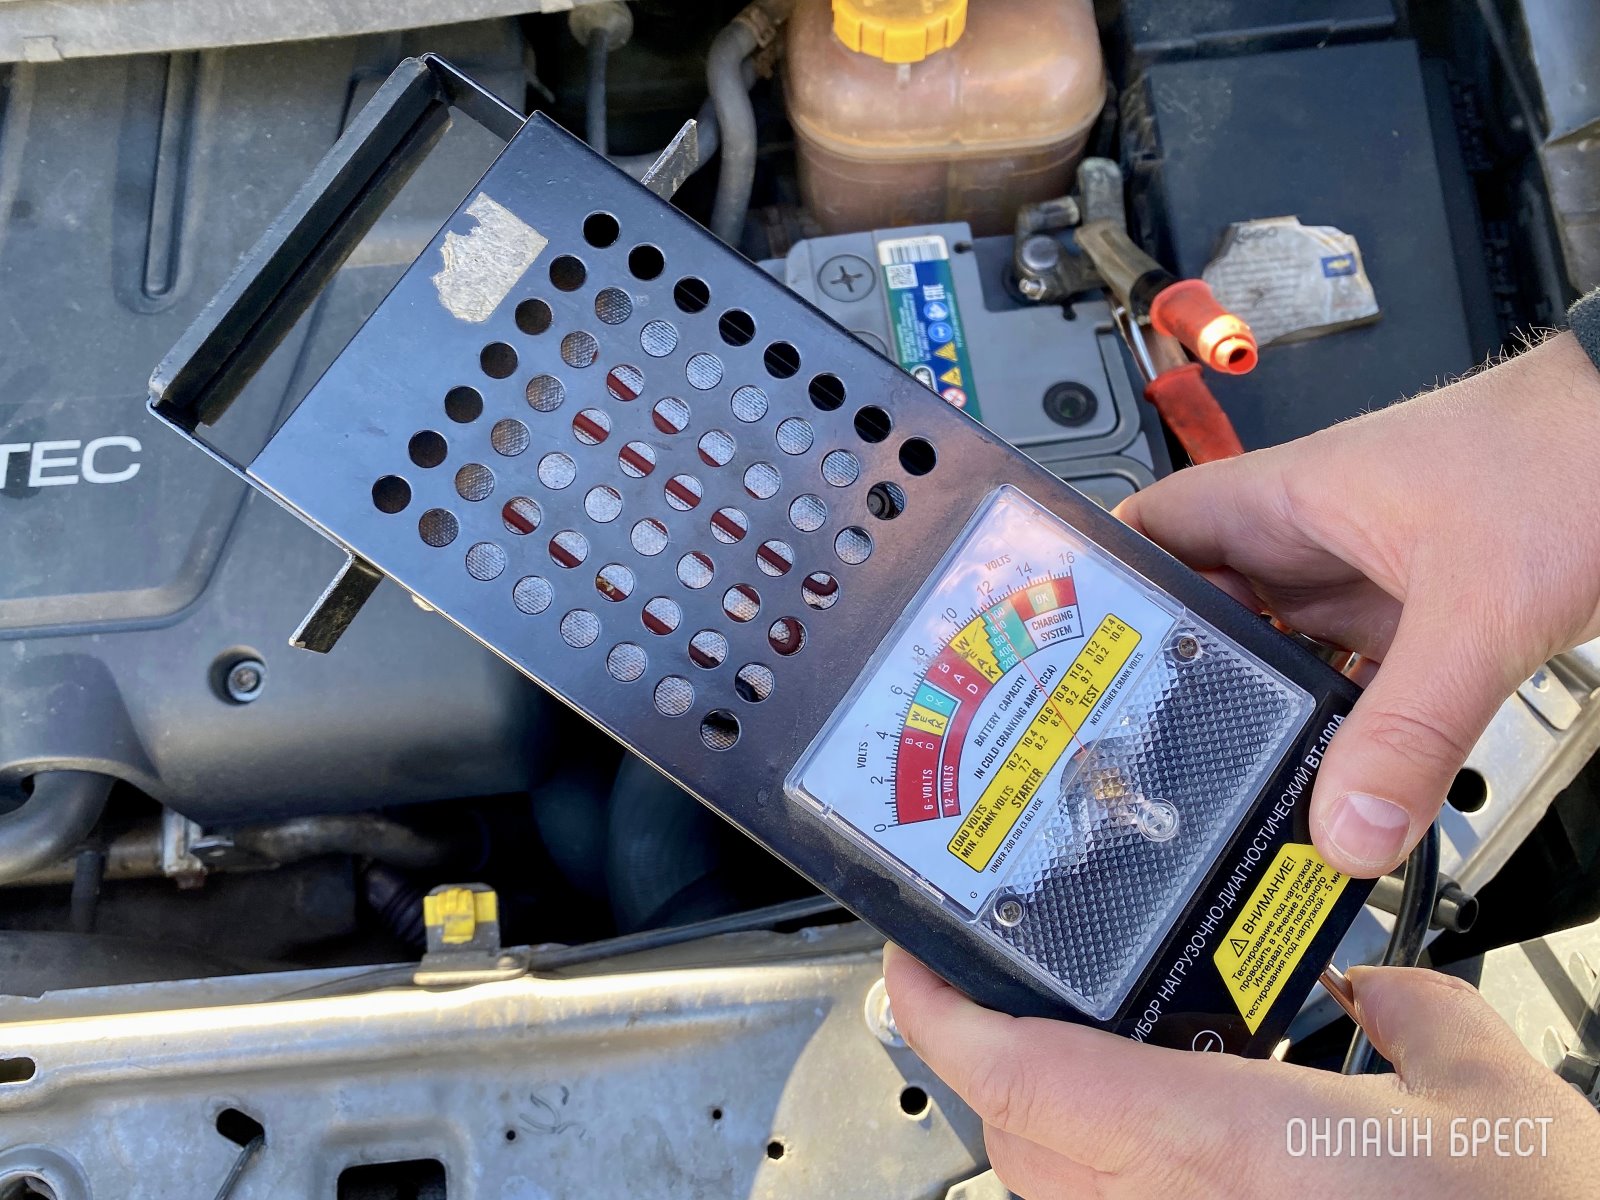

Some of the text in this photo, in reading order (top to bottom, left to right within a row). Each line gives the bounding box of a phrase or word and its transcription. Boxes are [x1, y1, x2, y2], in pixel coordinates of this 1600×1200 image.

[985, 554, 1012, 571] VOLTS
[1059, 551, 1075, 565] 16
[1016, 562, 1032, 577] 14
[976, 580, 994, 597] 12
[1035, 592, 1049, 605] OK
[941, 607, 957, 624] 10
[985, 606, 1005, 623] 100
[1031, 610, 1074, 631] CHARGING
[1040, 624, 1073, 642] SYSTEM
[913, 644, 926, 656] 8
[955, 636, 998, 679] WEAK
[1000, 643, 1014, 657] 400
[1002, 653, 1019, 669] 200
[938, 662, 979, 694] BAD
[890, 684, 903, 696] 6
[925, 694, 943, 706] OK
[911, 710, 945, 729] WEAK
[973, 674, 1027, 747] BATTERY CAPACITY
[875, 730, 889, 740] 4
[905, 737, 934, 750] BAD
[951, 618, 1116, 852] LOAD VOLTS 10.2 10.4 10.6 10.8 11.0 11.2 11.4
[960, 624, 1126, 859] MIN. CRANK VOLTS 7.7 8.2 8.7 9.2 9.7 10.2 10.6
[973, 768, 986, 780] IN
[981, 746, 1000, 769] COLD
[996, 707, 1027, 748] CRANKING
[857, 741, 868, 768] VOLTS
[1011, 684, 1100, 809] STARTER TEST
[989, 652, 1144, 874] UNDER 200 CID (3.6L) USE NEXT HIGHER CRANK VOLTS
[870, 776, 883, 784] 2
[873, 823, 887, 833] 0
[1130, 999, 1162, 1043] ИБОР
[1157, 766, 1313, 1002] НАГРУЗОЧНО-ДИАГНОСТИЧЕСКИЙ
[1242, 856, 1297, 935] ВНИМАНИЕ!
[1231, 858, 1314, 981] Тестирование под нагрузкой
[1253, 876, 1327, 988] Интервал для повторного
[1239, 946, 1272, 993] проводить
[1273, 901, 1299, 937] течение
[1245, 959, 1287, 1020] тестирования
[1283, 941, 1300, 959] под
[1295, 897, 1325, 941] нагрузкой
[1324, 884, 1333, 892] 5
[1330, 871, 1342, 885] ми
